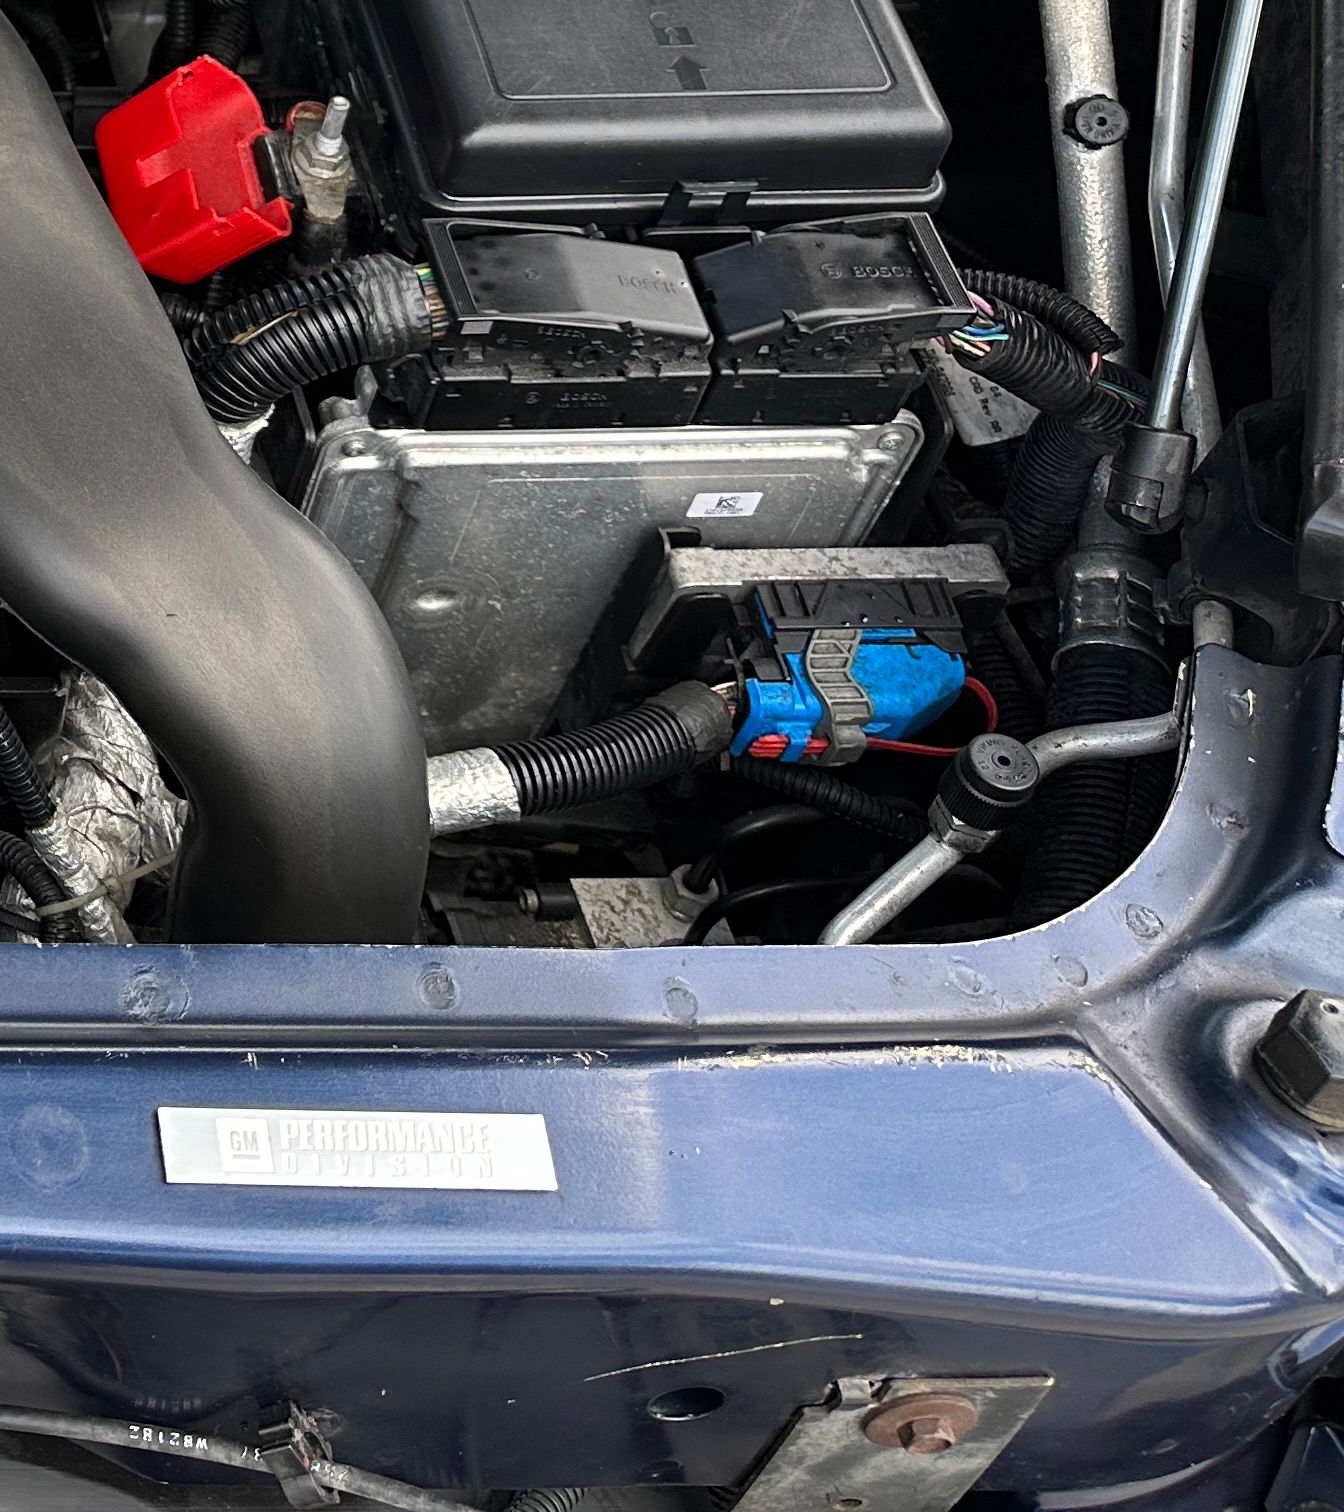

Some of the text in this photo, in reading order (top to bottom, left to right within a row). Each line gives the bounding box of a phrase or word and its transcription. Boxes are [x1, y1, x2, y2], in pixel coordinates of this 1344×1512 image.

[852, 265, 916, 279] BOSCH
[229, 1130, 259, 1152] GM
[279, 1118, 492, 1155] PERFORMANCE
[280, 1152, 493, 1179] DIVISION
